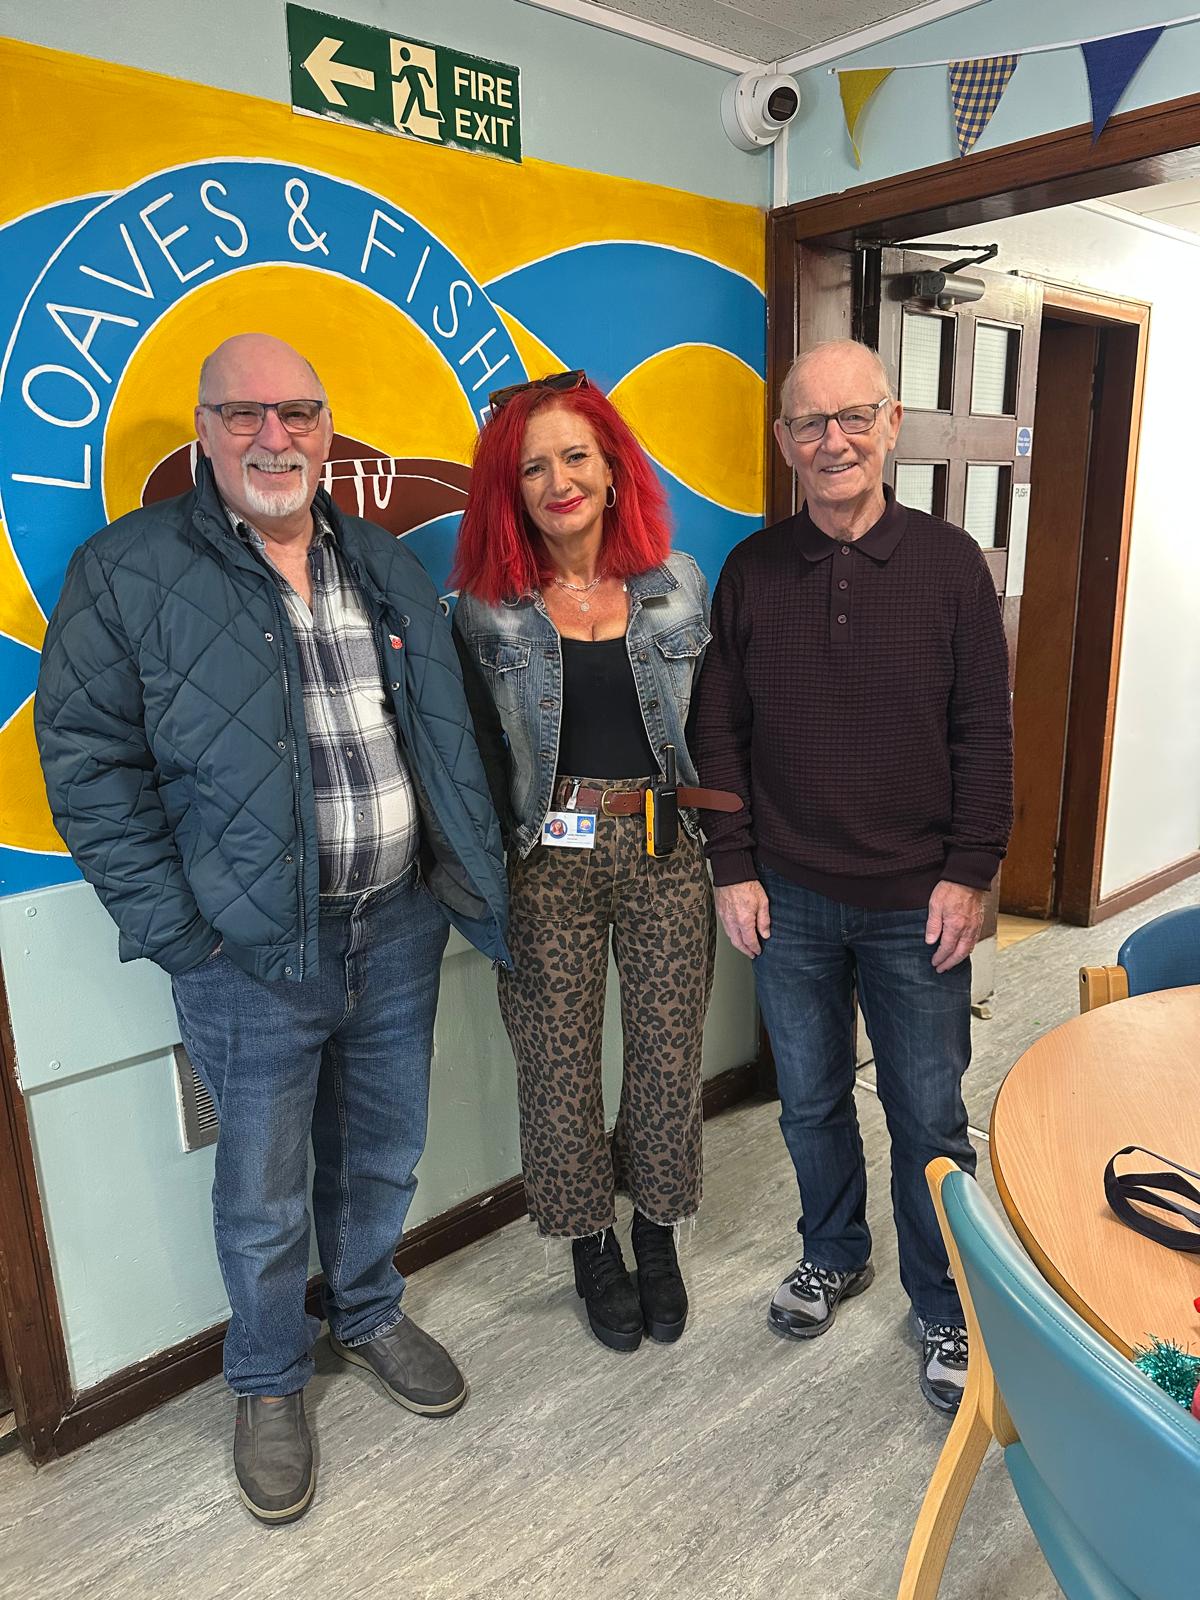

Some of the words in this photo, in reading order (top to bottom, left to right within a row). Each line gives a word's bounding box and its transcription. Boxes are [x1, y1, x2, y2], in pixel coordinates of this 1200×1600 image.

[454, 66, 513, 109] FIRE
[455, 108, 514, 147] EXIT
[11, 179, 249, 489] LOAVES
[285, 178, 330, 256] &
[1014, 487, 1029, 498] PUSH
